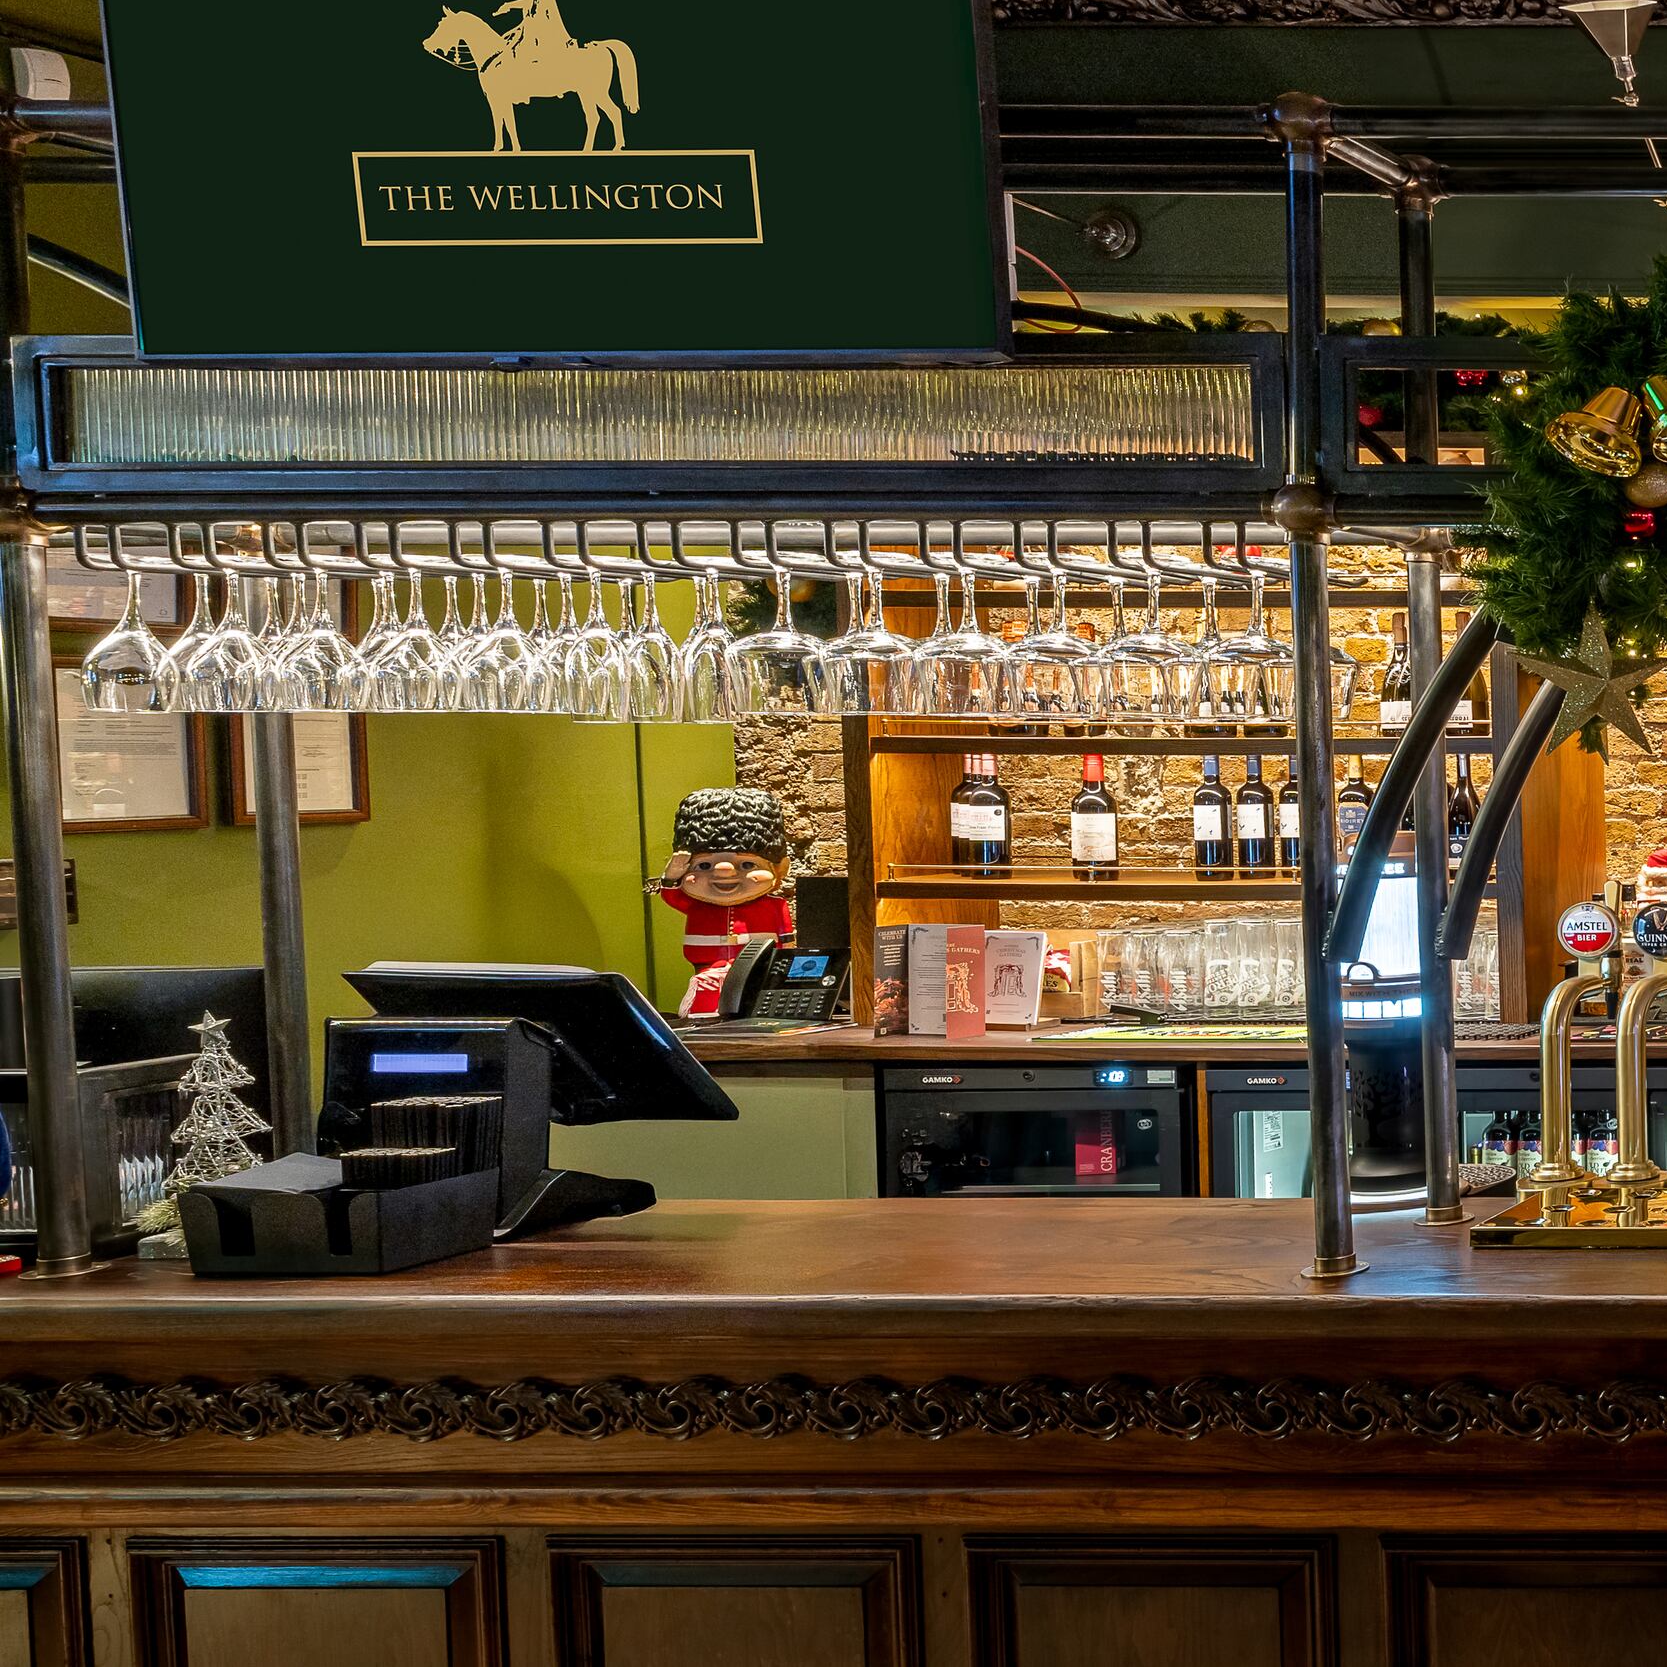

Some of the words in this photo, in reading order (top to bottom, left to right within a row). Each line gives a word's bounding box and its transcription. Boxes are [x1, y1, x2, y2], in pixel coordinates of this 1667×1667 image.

[378, 185, 454, 211] THE
[467, 183, 723, 211] WELLINGTON
[1566, 921, 1607, 931] AMSTEL
[951, 947, 980, 955] GATHERS
[1246, 1077, 1277, 1085] GAMKO
[1100, 1110, 1113, 1172] CRANBERR
